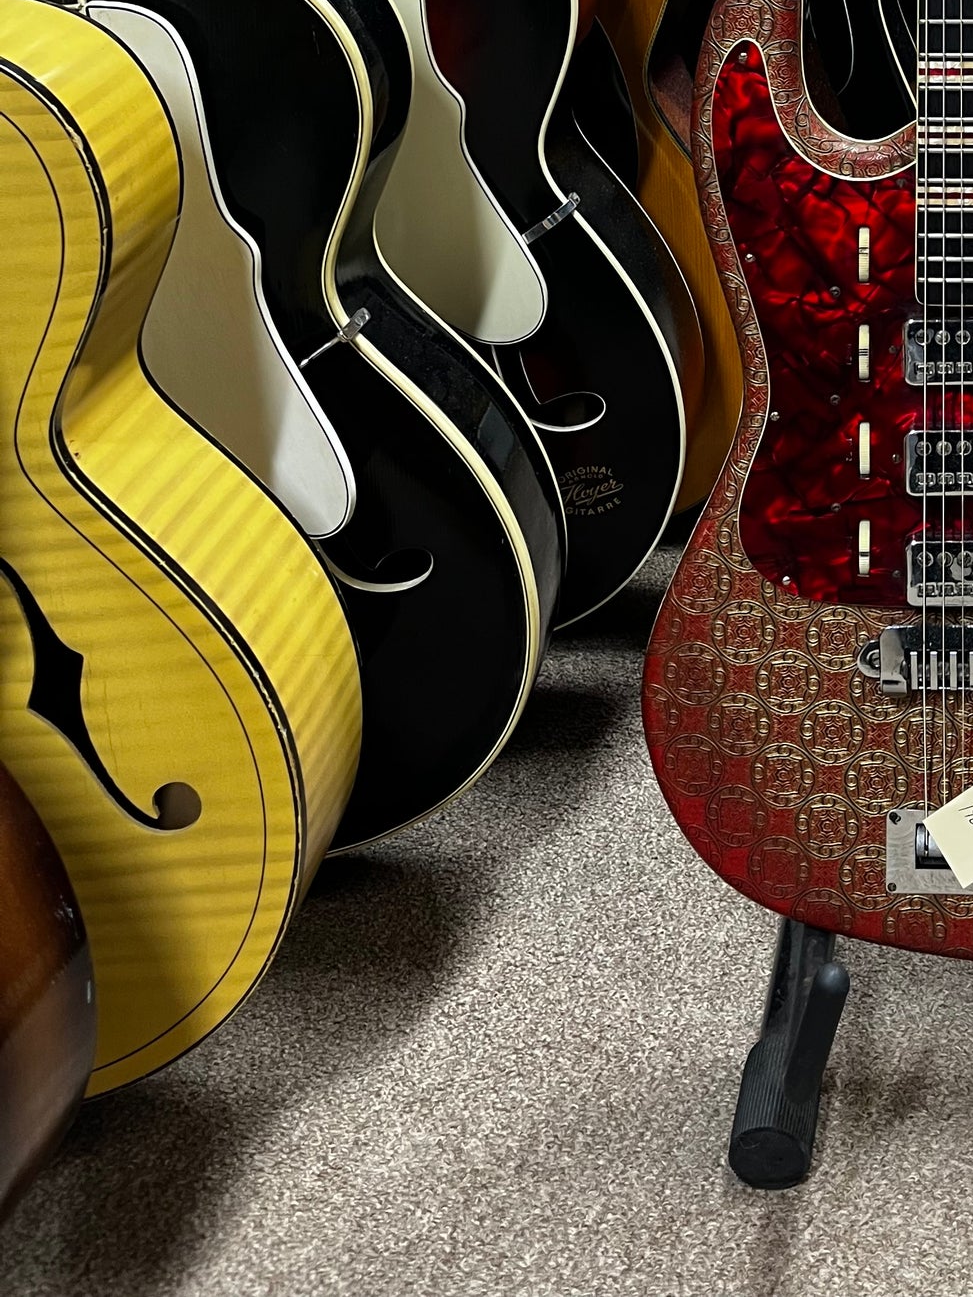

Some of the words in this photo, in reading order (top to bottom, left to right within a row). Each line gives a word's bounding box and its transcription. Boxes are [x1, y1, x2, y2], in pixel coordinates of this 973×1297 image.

[558, 465, 614, 484] ORIGINAL
[560, 478, 624, 506] Hoyer
[565, 497, 622, 516] GITARRE
